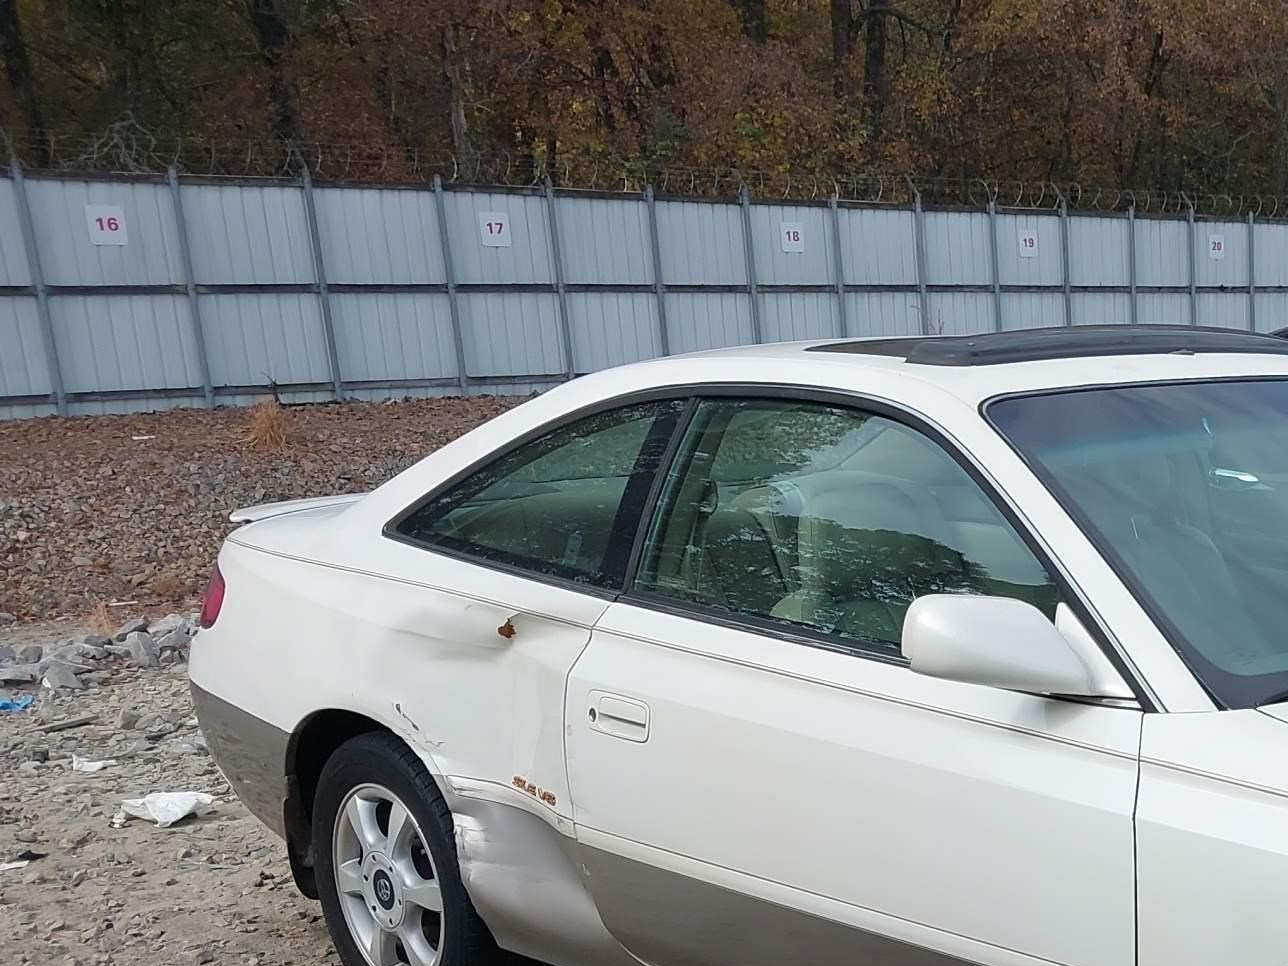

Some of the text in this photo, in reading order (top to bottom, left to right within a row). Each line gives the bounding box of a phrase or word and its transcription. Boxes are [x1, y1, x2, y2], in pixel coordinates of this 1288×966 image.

[95, 217, 119, 232] 16
[485, 221, 504, 234] 17
[785, 230, 800, 242] 18
[1023, 237, 1035, 249] 19
[1211, 241, 1222, 252] 20
